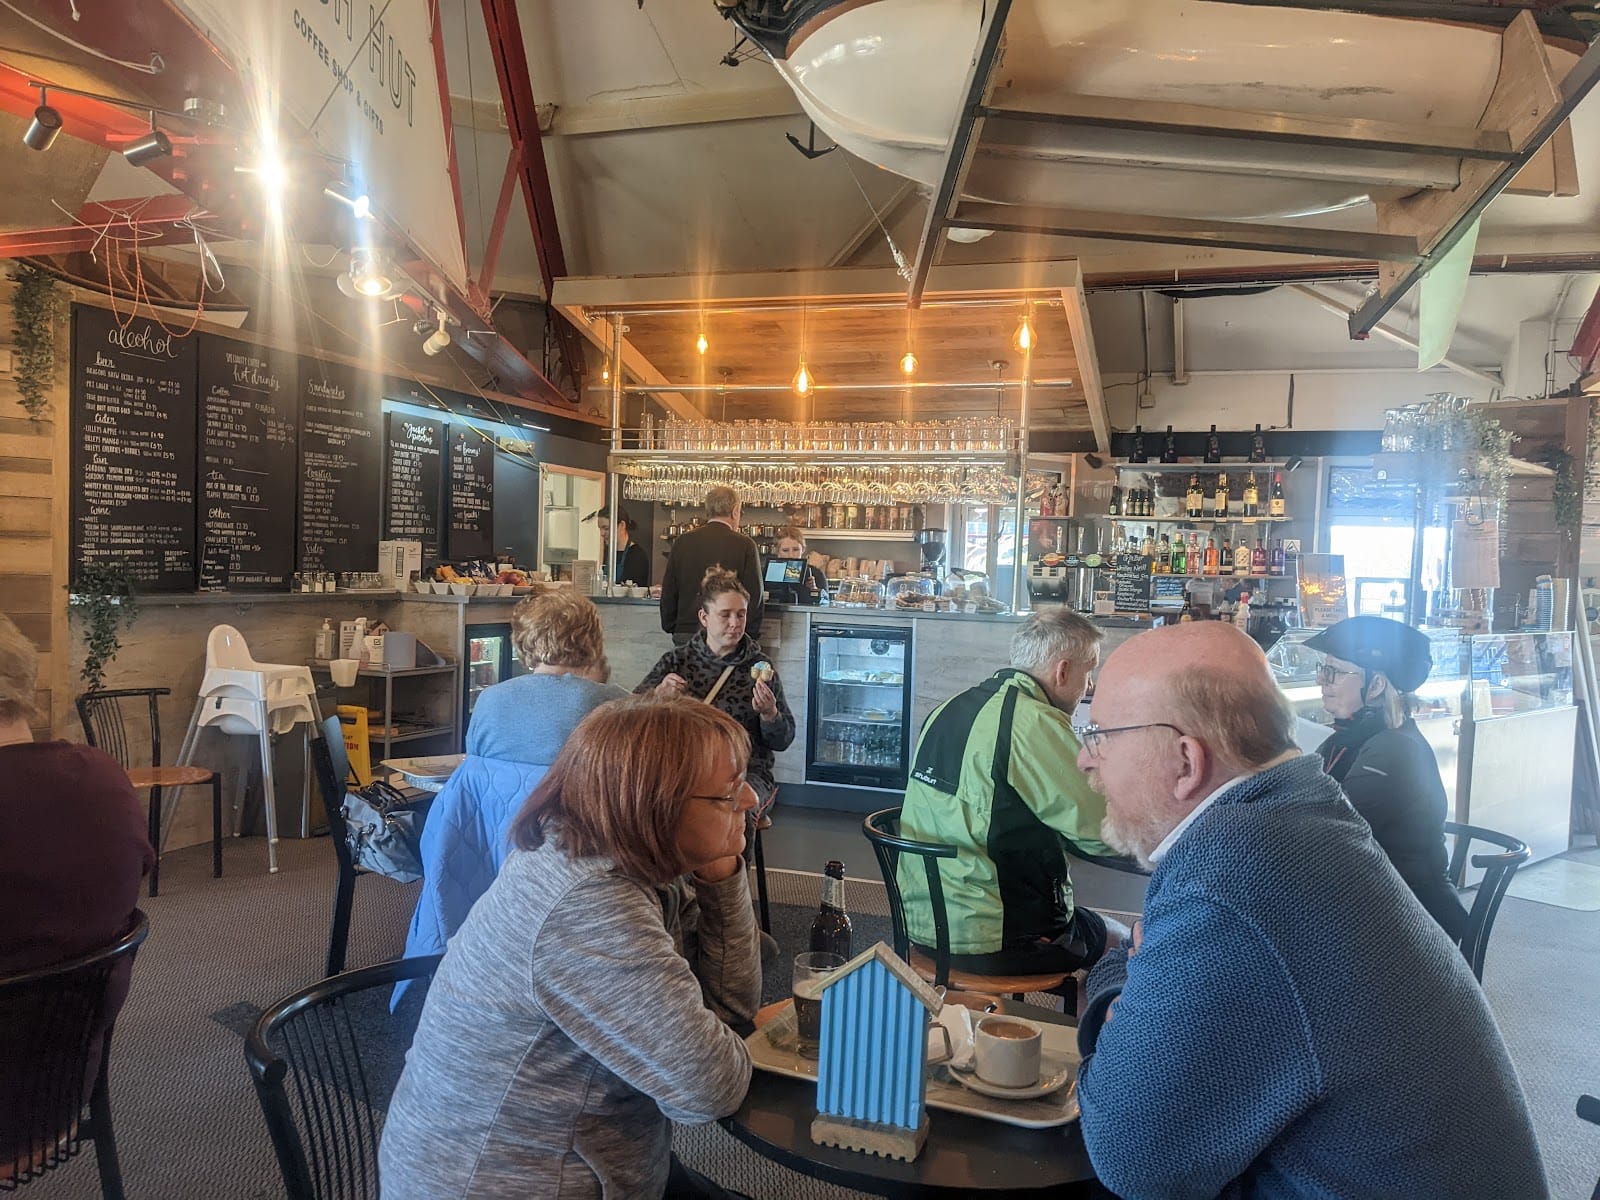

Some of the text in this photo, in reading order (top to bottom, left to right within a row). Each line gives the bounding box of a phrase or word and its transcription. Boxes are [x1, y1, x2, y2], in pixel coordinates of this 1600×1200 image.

[293, 8, 330, 67] COFFEE
[332, 58, 354, 96] SHOP
[356, 90, 361, 107] &
[364, 100, 384, 136] GIFTS
[369, 4, 416, 128] HUT
[108, 324, 178, 358] alcohol
[233, 364, 251, 383] hot
[93, 453, 108, 465] Gin
